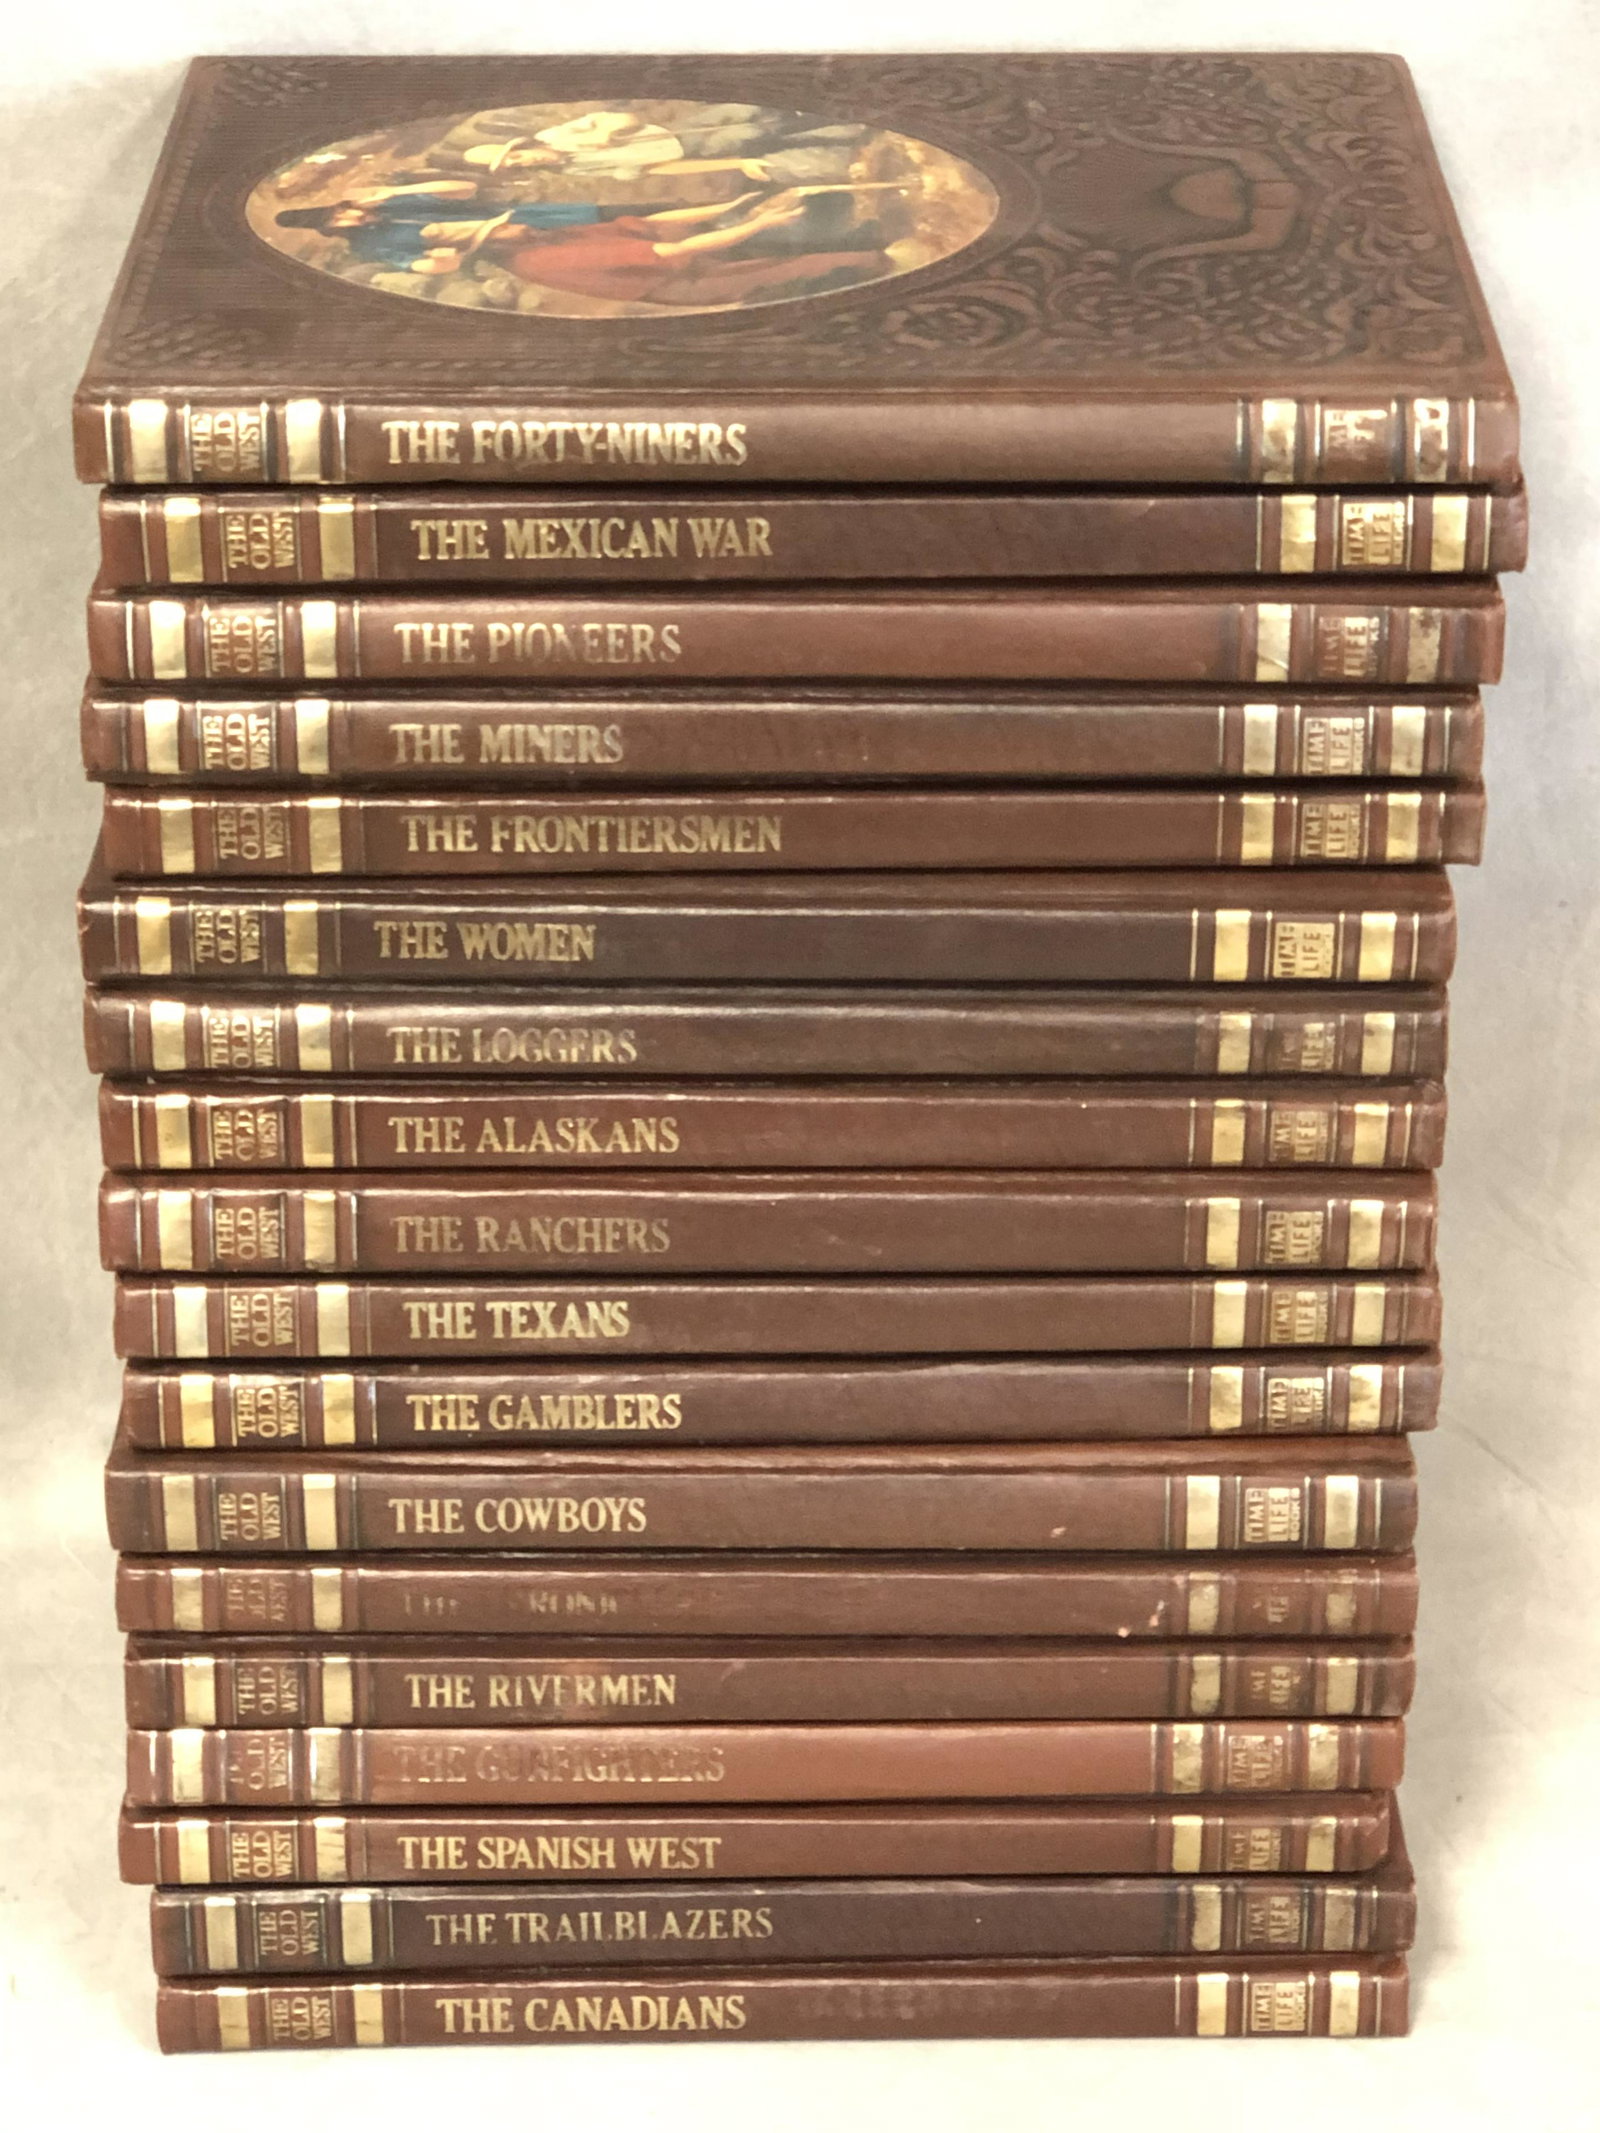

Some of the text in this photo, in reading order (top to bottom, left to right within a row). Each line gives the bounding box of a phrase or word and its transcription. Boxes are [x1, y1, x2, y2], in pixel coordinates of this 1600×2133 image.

[190, 412, 212, 472] THE
[214, 411, 237, 472] OLD
[381, 420, 748, 466] THE FORTY-NINERS
[227, 514, 248, 568] THE
[249, 513, 271, 570] OLD
[410, 517, 773, 561] THE MEXICAN WAR
[209, 617, 231, 672] THE
[231, 615, 254, 673] OLD
[394, 622, 475, 664] THE
[225, 713, 247, 771] OLD
[389, 723, 624, 764] THE MINERS
[1330, 726, 1351, 771] LIFE
[400, 814, 783, 854] THE FRONTIERSMEN
[1329, 811, 1348, 854] LIFE
[374, 920, 597, 962] THE WOMEN
[1302, 932, 1321, 973] LIFE
[386, 1026, 462, 1064] THE
[388, 1115, 681, 1153] THE ALASKANS
[1296, 1119, 1316, 1159] LIFE
[215, 1208, 235, 1259] THE
[236, 1207, 257, 1260] OLD
[390, 1215, 671, 1253] THE RANCHERS
[1292, 1219, 1311, 1260] LIFE
[230, 1294, 250, 1347] THE
[251, 1293, 272, 1348] OLD
[273, 1292, 294, 1346] WEST
[402, 1300, 631, 1339] THE TEXANS
[237, 1388, 256, 1437] THE
[257, 1387, 278, 1439] OLD
[279, 1386, 300, 1438] WEST
[405, 1393, 682, 1431] THE GAMBLERS
[218, 1493, 238, 1541] THE
[239, 1492, 260, 1541] OLD
[261, 1492, 282, 1540] WEST
[389, 1497, 648, 1533] THE COWBOYS
[1269, 1495, 1288, 1538] LIFE
[257, 1666, 277, 1715] OLD
[404, 1674, 475, 1708] THE
[393, 1745, 467, 1783] THE
[231, 1832, 250, 1878] THE
[251, 1830, 272, 1878] OLD
[273, 1830, 293, 1877] WEST
[397, 1836, 722, 1870] THE SPANISH WEST
[258, 1911, 278, 1955] THE
[279, 1909, 300, 1956] OLD
[426, 1914, 497, 1945] THE
[271, 1998, 291, 2041] THE
[291, 1997, 312, 2041] OLD
[435, 1995, 747, 2034] THE CANADIANS
[1276, 1990, 1294, 2027] LIFE
